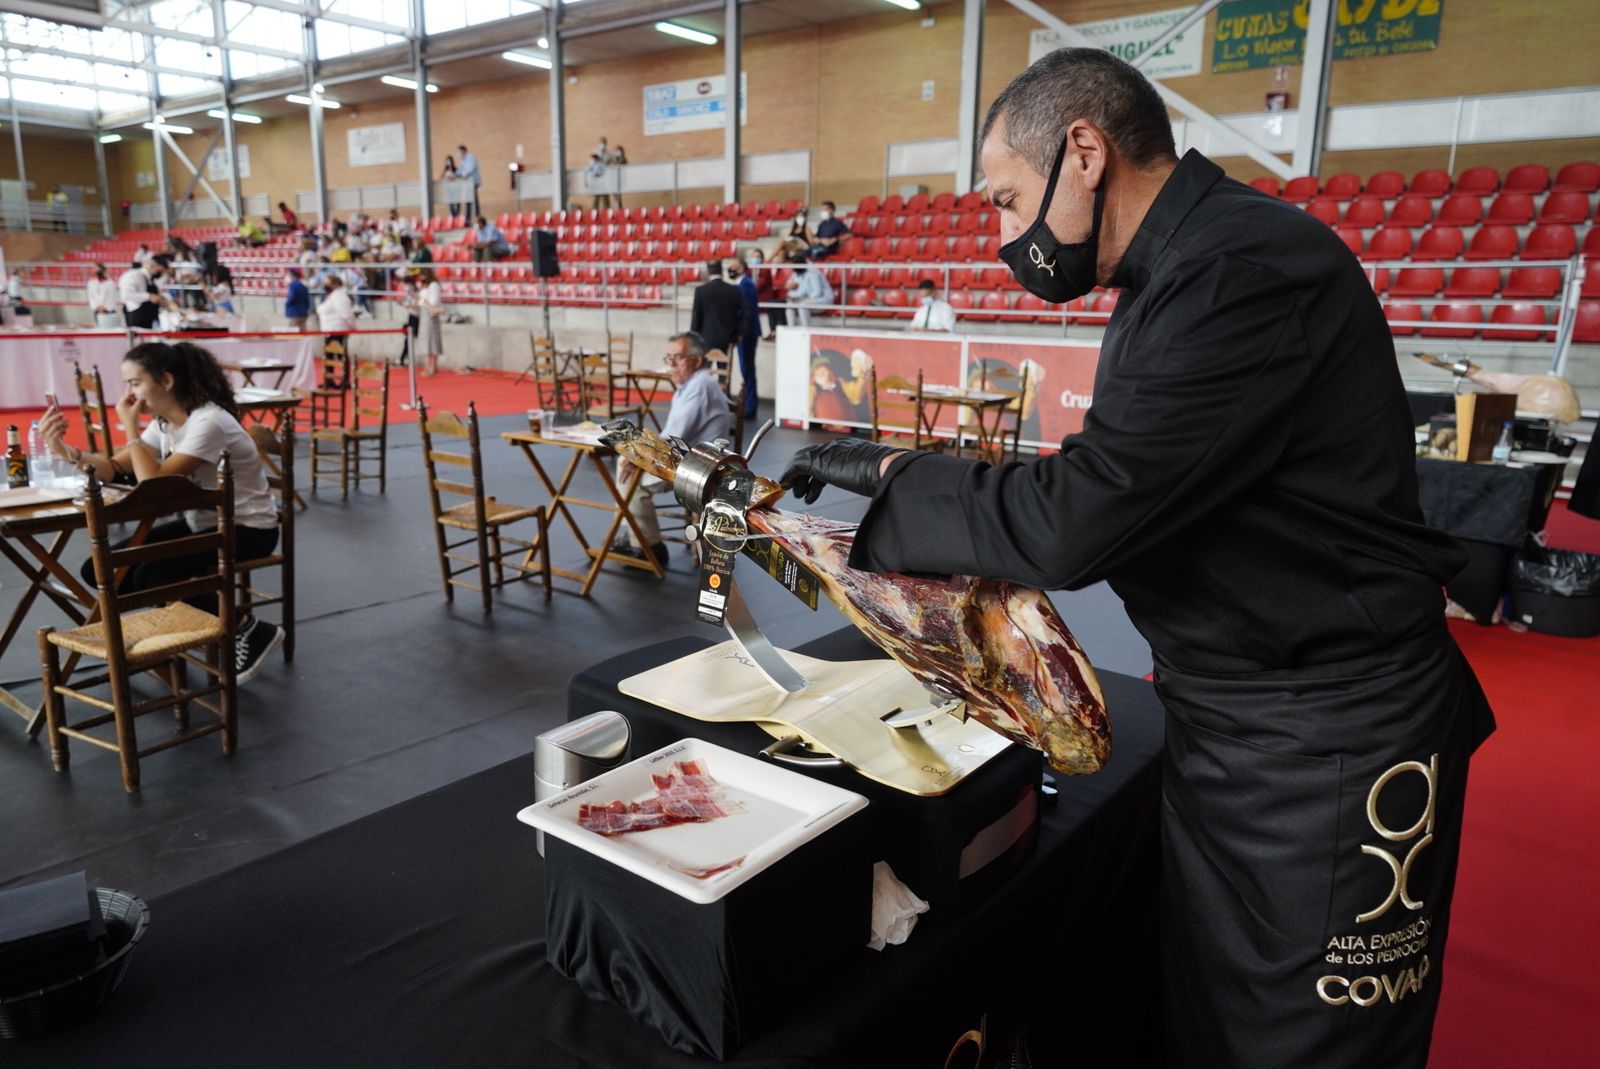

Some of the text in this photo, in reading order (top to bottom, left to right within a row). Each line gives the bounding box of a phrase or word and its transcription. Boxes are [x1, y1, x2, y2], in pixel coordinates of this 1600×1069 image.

[1060, 389, 1093, 409] Cru
[1327, 935, 1367, 951] ALTA
[1325, 951, 1344, 964] de
[1347, 953, 1375, 965] LOS
[1316, 954, 1431, 1007] COVAP
